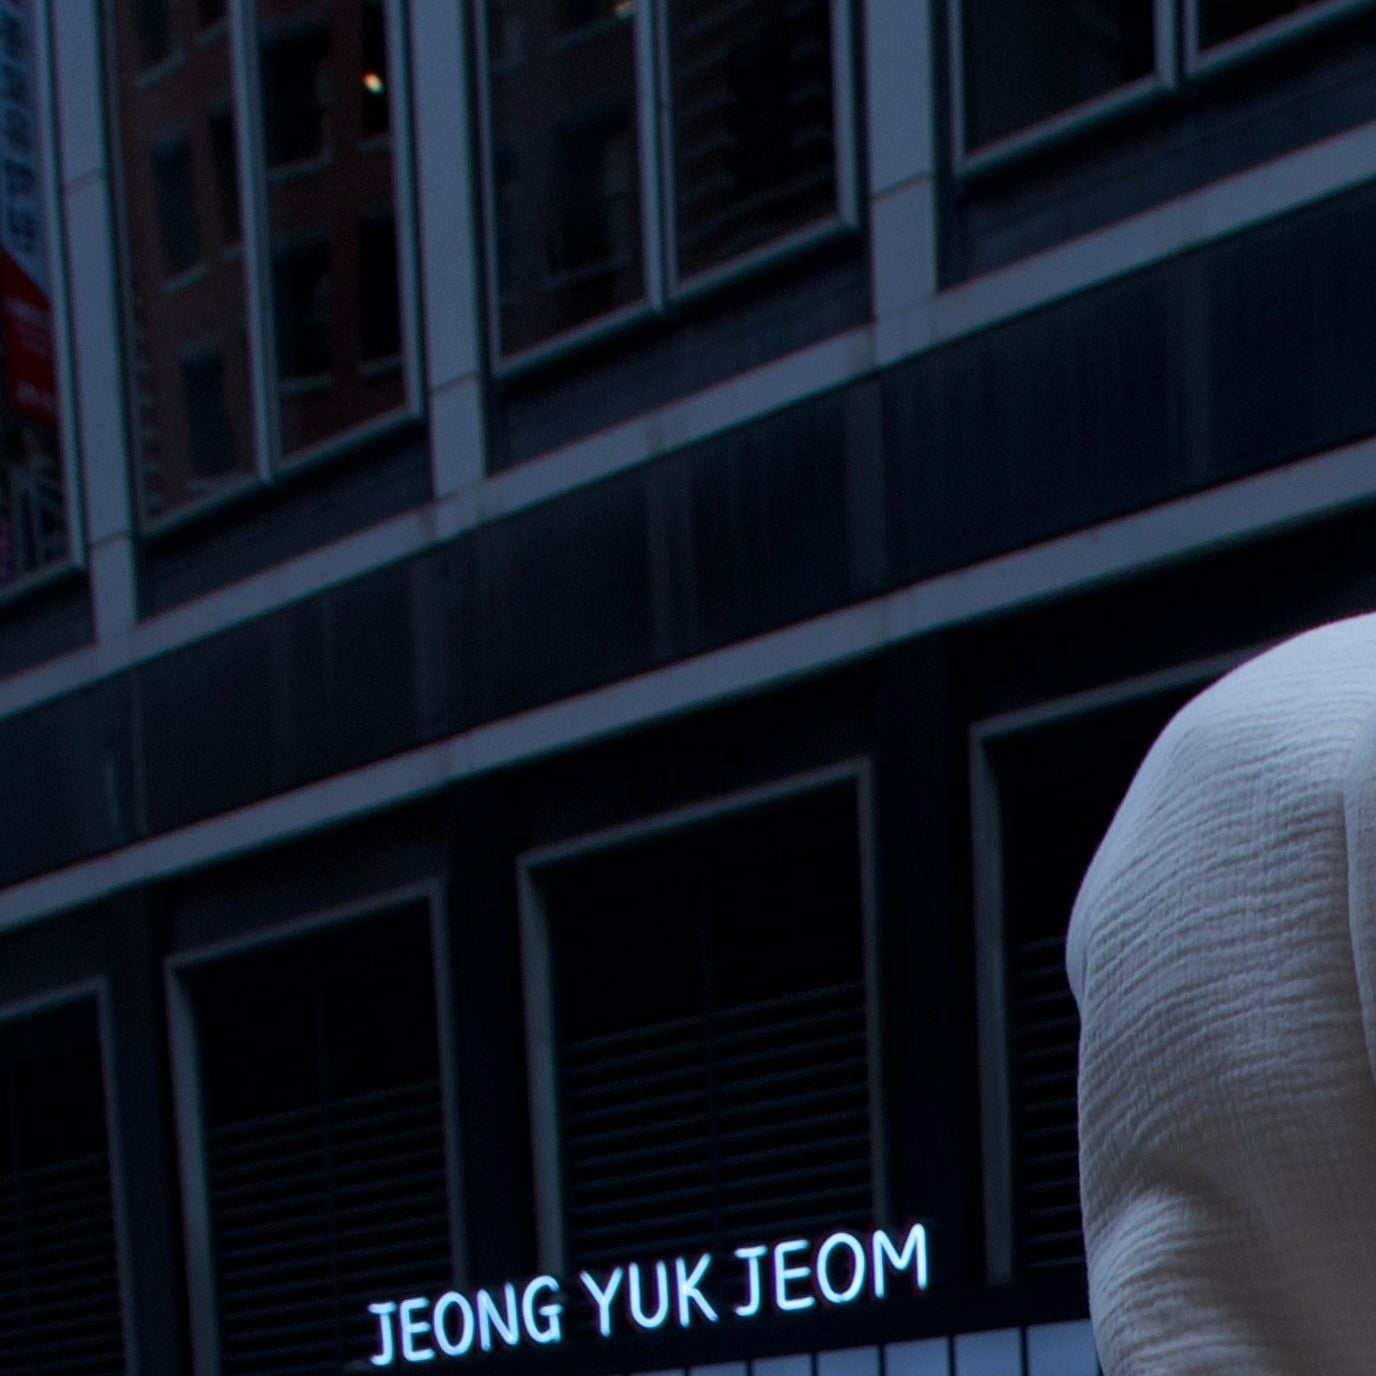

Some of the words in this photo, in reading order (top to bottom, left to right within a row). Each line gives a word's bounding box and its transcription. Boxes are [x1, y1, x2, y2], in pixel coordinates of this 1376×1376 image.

[366, 1275, 564, 1367] JEONG
[579, 1253, 720, 1338] YUK
[732, 1222, 930, 1318] JEOM
